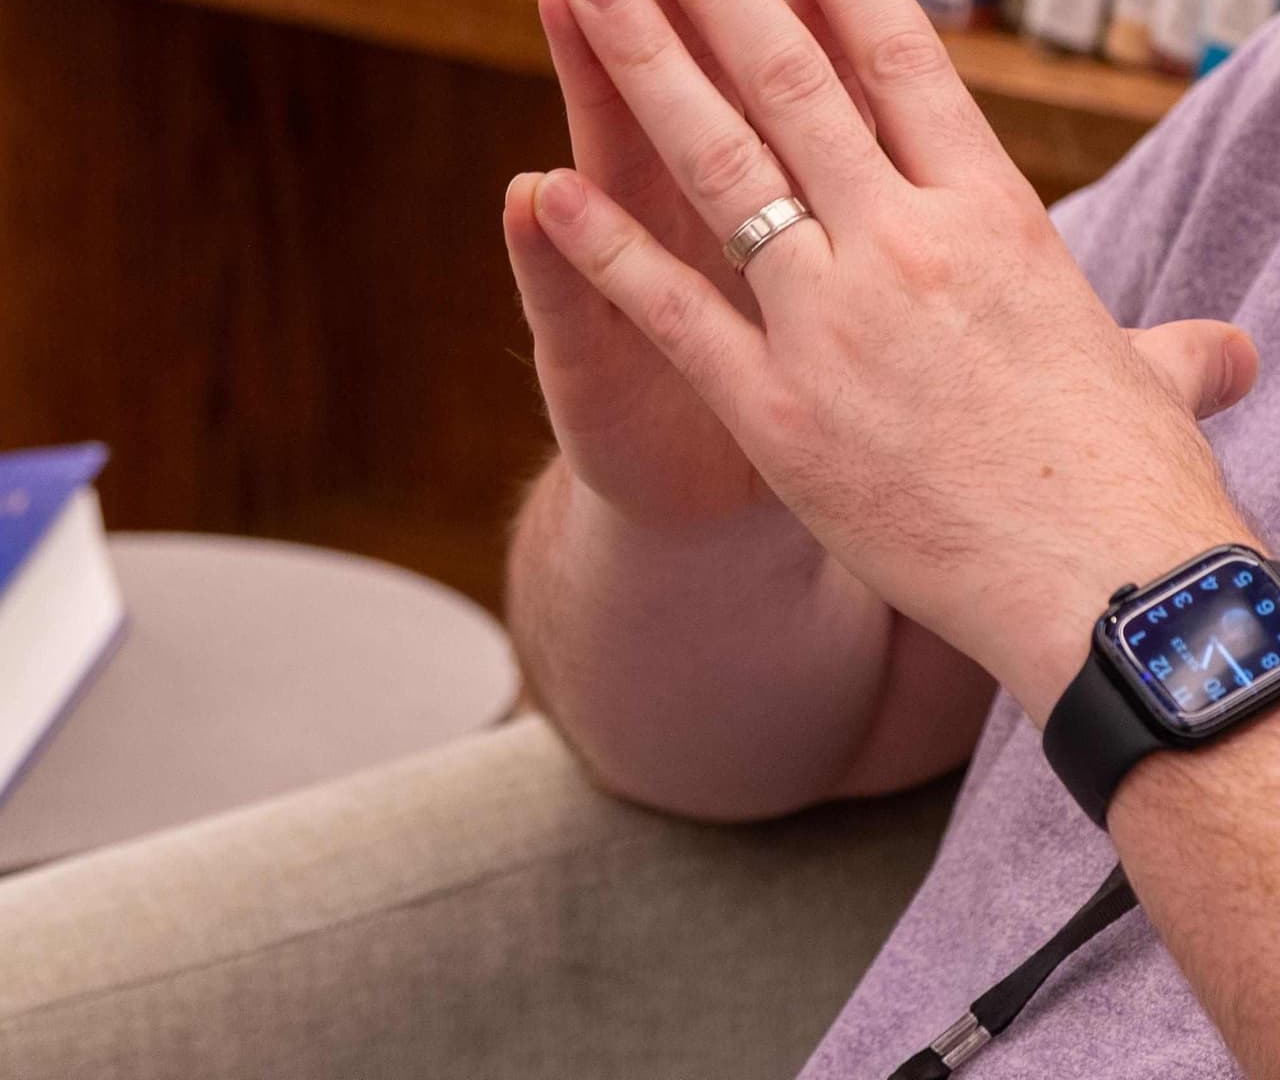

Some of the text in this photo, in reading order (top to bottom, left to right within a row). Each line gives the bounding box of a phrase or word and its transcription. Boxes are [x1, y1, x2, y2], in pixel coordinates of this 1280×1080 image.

[1200, 575, 1219, 591] 4
[1233, 570, 1253, 588] 5
[1173, 591, 1193, 608] 3
[1256, 599, 1275, 616] 6
[1146, 606, 1169, 624] 2
[1129, 629, 1147, 646] 1
[1149, 654, 1173, 680] 12
[1261, 651, 1280, 669] 8
[1204, 677, 1227, 701] 10
